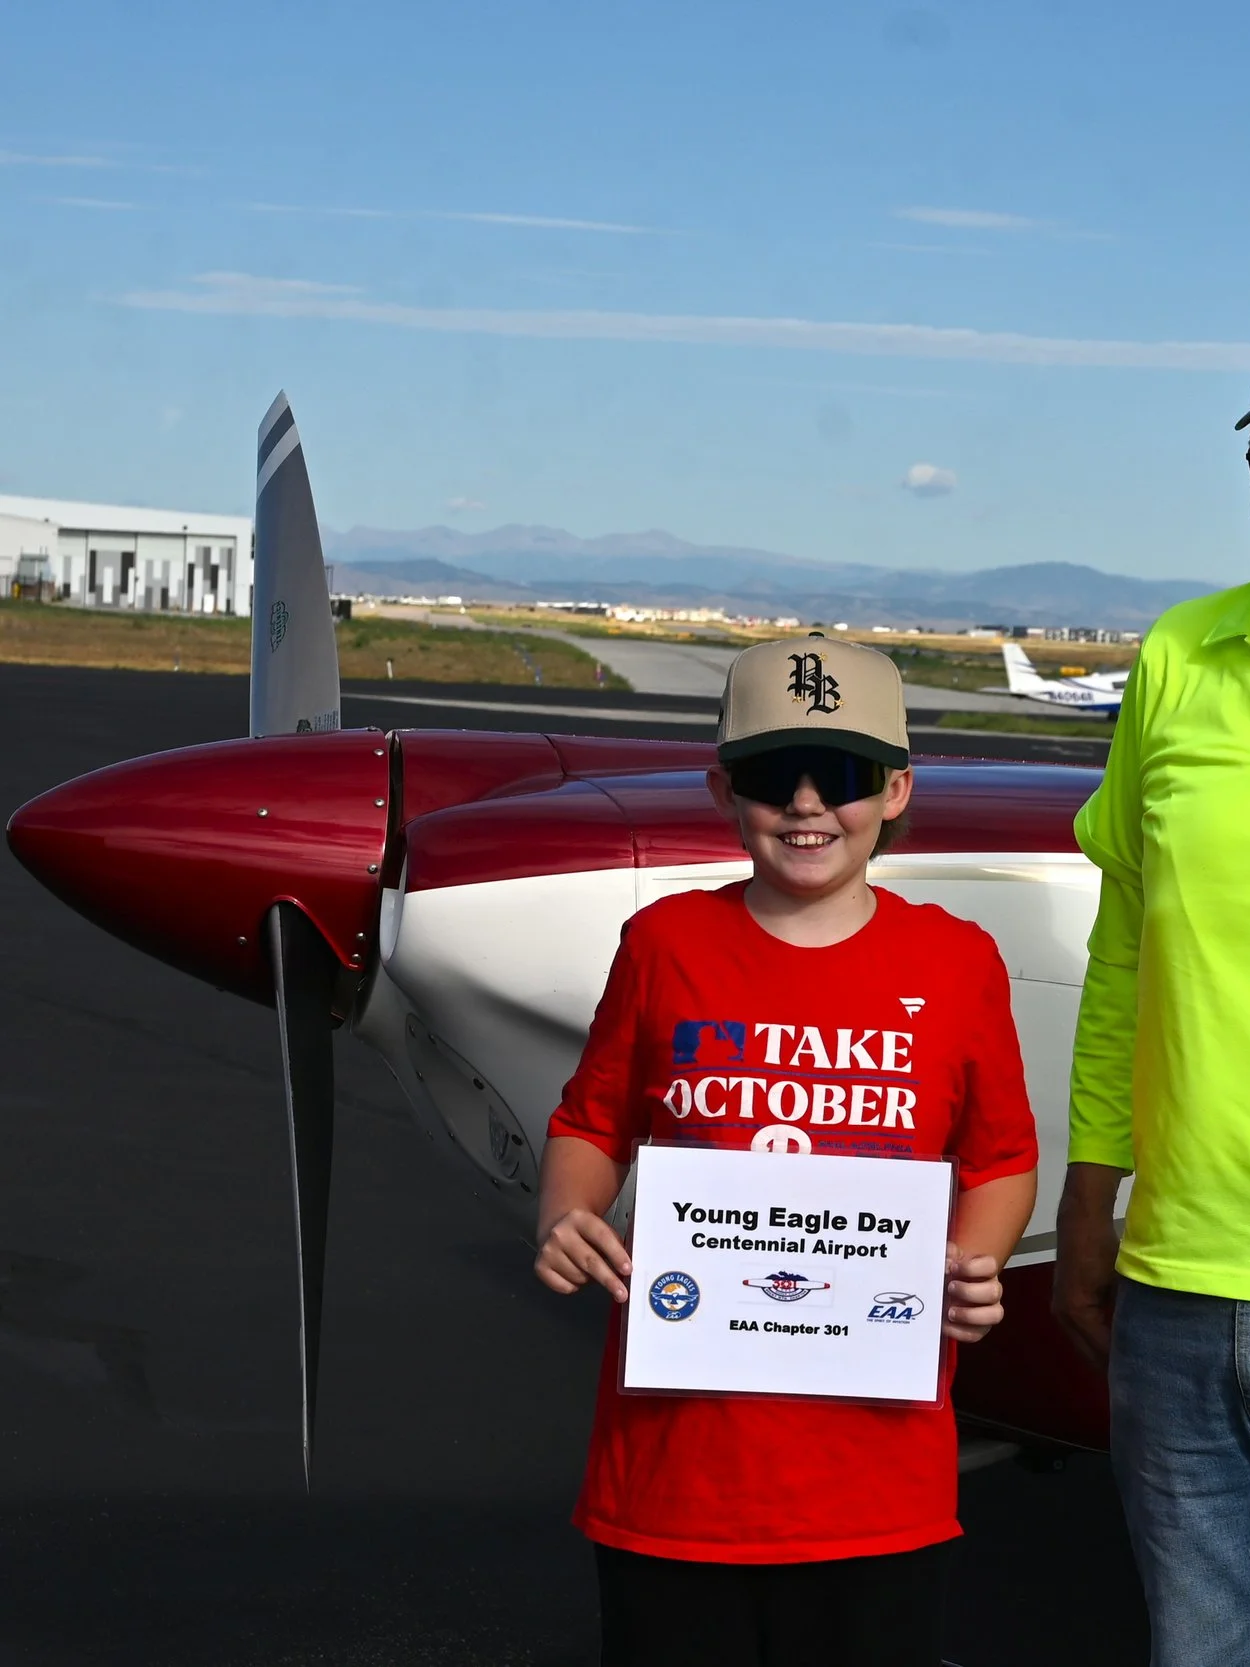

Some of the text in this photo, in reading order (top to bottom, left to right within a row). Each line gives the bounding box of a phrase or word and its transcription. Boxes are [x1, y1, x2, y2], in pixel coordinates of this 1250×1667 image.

[754, 1023, 913, 1074] TAKE
[663, 1076, 917, 1130] OCTOBER
[673, 1202, 911, 1239] Young Eagle Day
[691, 1233, 888, 1260] Centennial Airport
[655, 1274, 696, 1292] YOUNG EAGLES
[867, 1305, 913, 1320] EAA
[729, 1320, 849, 1337] EAA Chapter 301
